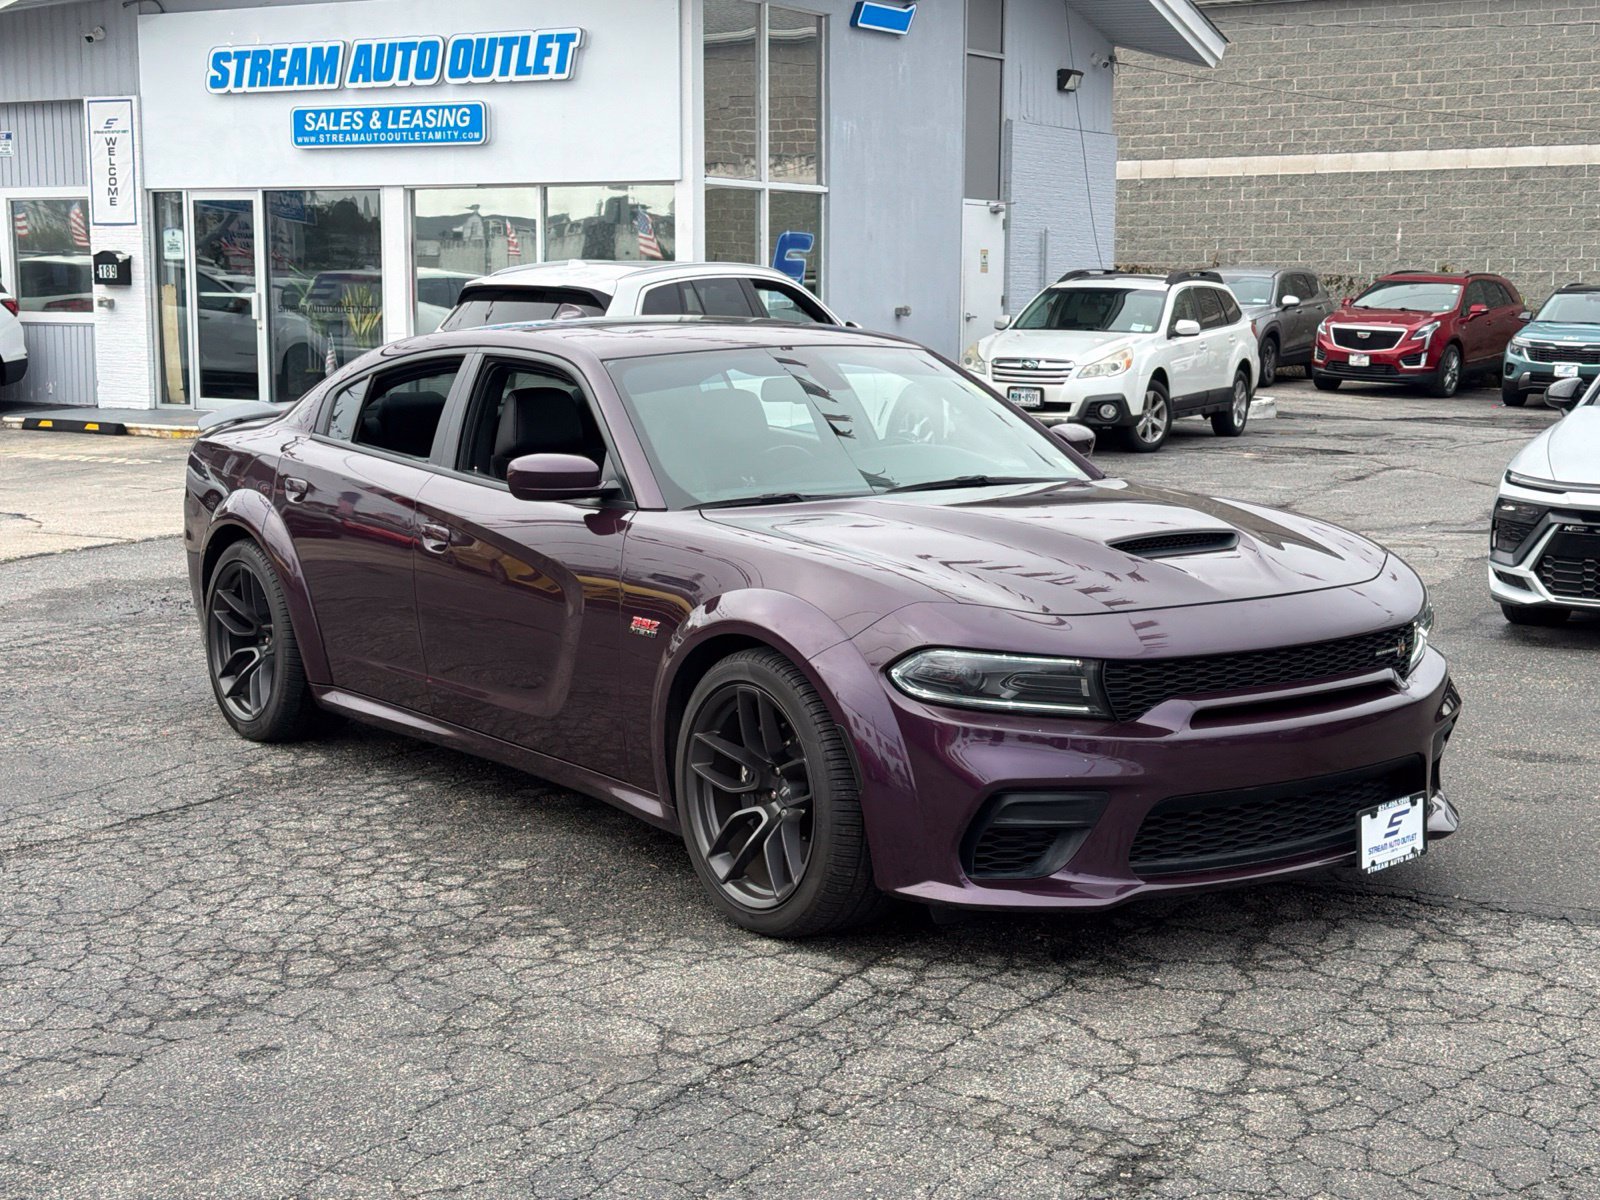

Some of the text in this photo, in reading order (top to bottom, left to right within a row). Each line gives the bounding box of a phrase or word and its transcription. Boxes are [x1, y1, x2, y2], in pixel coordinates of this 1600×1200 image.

[208, 32, 578, 90] STREAM AUTO OUTLET
[304, 107, 471, 131] SALES & LEASING
[105, 137, 118, 206] WELCOME
[100, 265, 117, 279] 189
[1368, 842, 1388, 856] STREAM
[1388, 838, 1401, 849] AUTO
[1400, 832, 1417, 845] OUTLET
[1367, 861, 1389, 875] STREAM
[1389, 856, 1405, 867] AUTO
